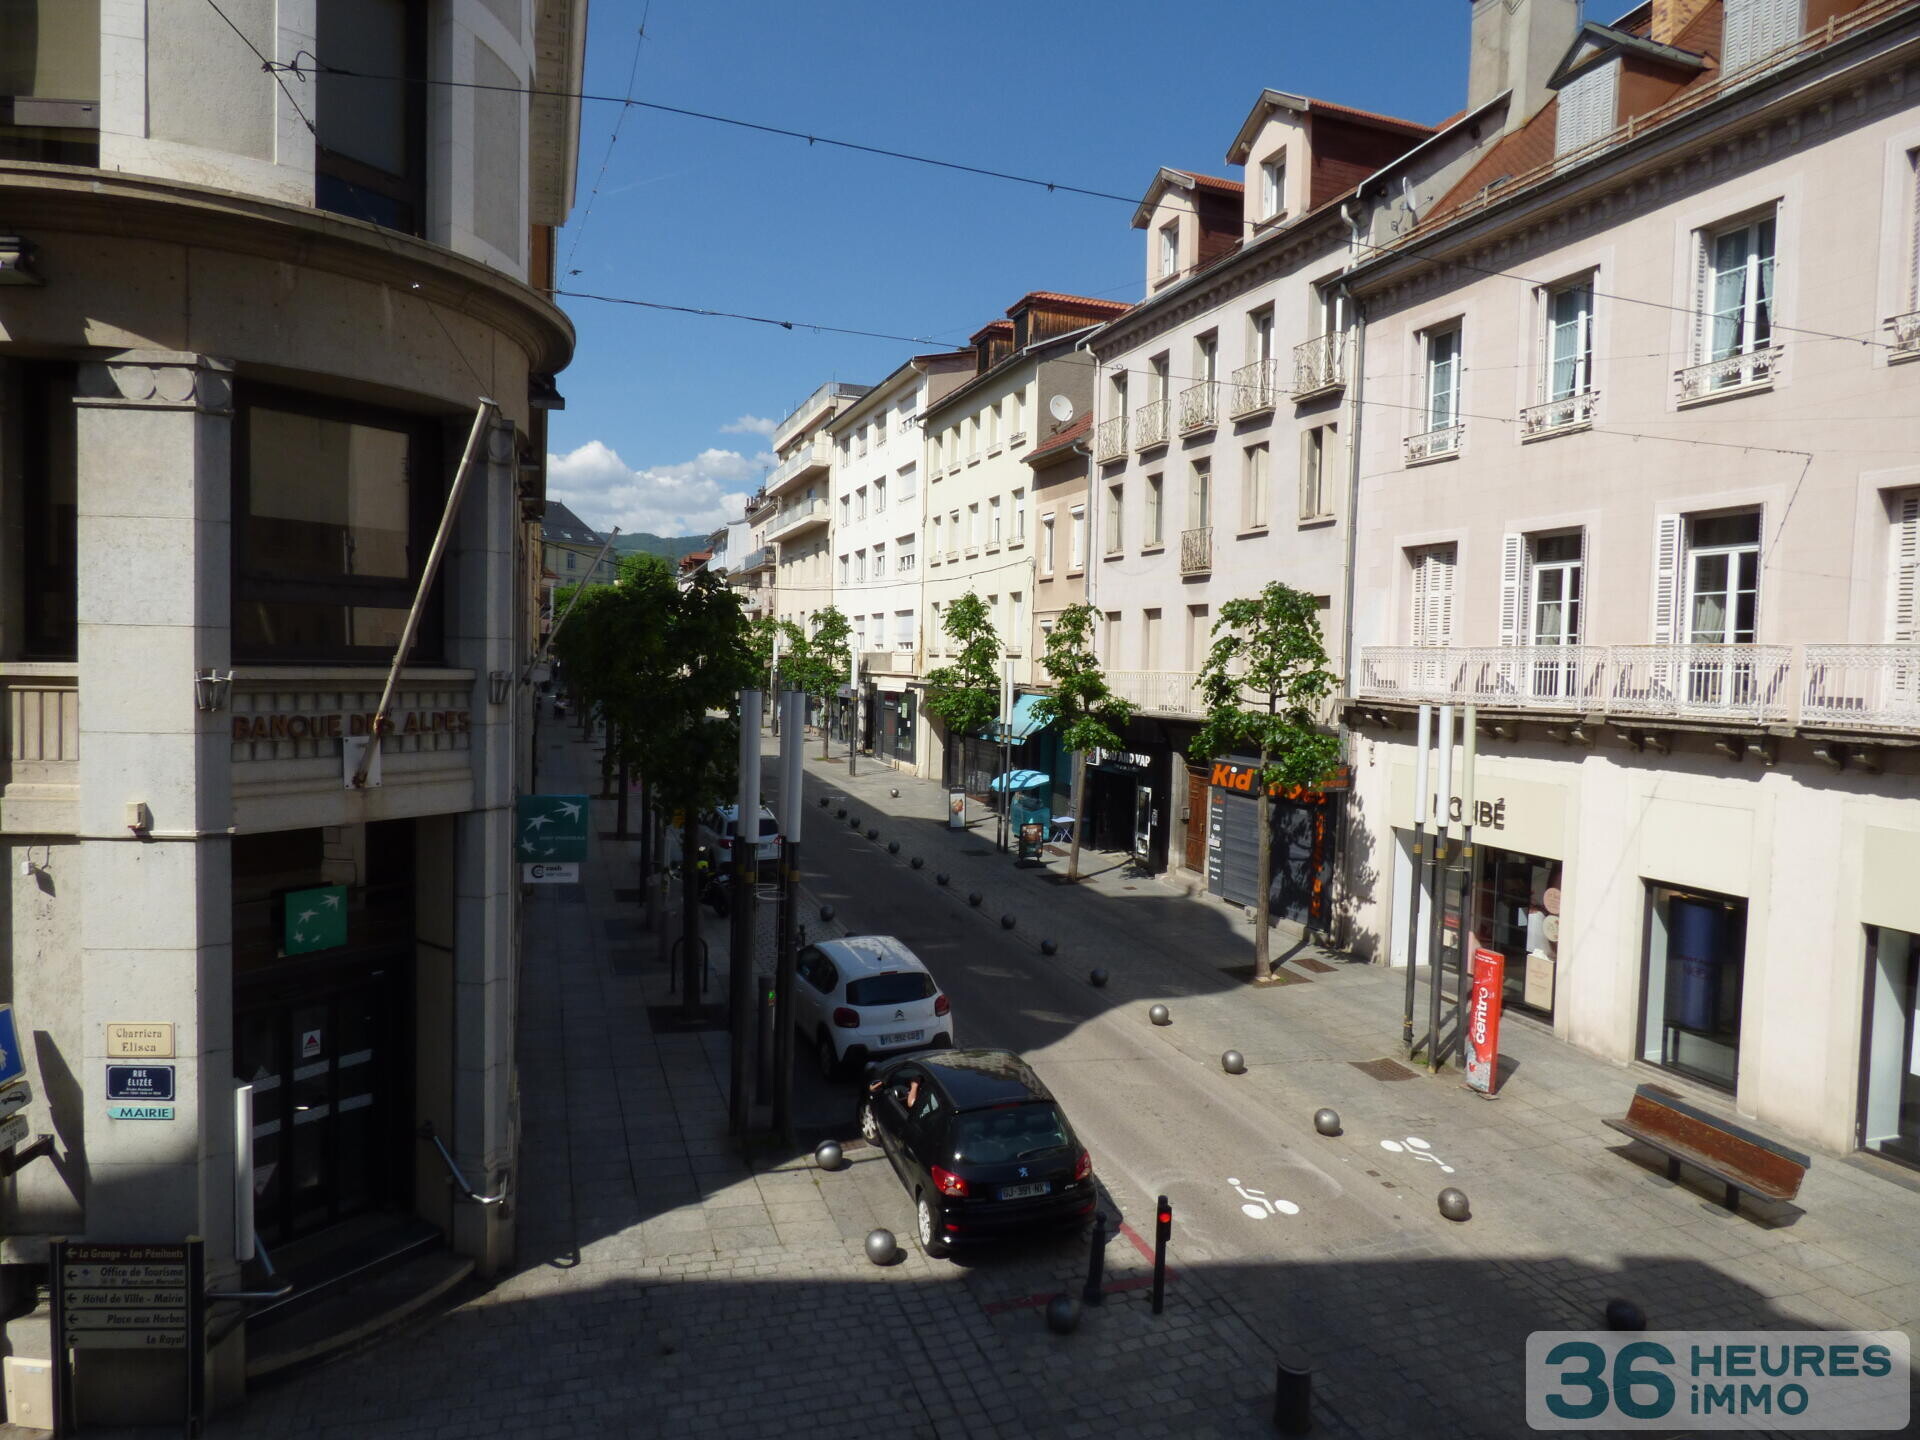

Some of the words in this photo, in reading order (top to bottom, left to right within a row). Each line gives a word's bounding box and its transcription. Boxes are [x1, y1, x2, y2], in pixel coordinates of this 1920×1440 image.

[232, 714, 342, 738] BANQUE
[1135, 753, 1151, 767] VAP
[1211, 763, 1255, 792] Kid
[1433, 793, 1506, 831] OIBÉ
[127, 1078, 153, 1087] ÉLIZÉE
[120, 1108, 169, 1118] MAIRIE
[90, 1248, 121, 1260] Grange
[129, 1248, 142, 1258] Les
[100, 1267, 128, 1277] Office
[130, 1267, 141, 1276] de
[144, 1267, 184, 1276] Tourisme
[82, 1293, 108, 1304] Hôtel
[110, 1294, 121, 1304] de
[124, 1294, 144, 1303] Ville
[153, 1294, 184, 1303] Mairie
[107, 1313, 131, 1324] Place
[134, 1315, 150, 1323] aux
[153, 1313, 185, 1323] Herbes
[147, 1335, 156, 1344] Le
[159, 1334, 185, 1345] Royal
